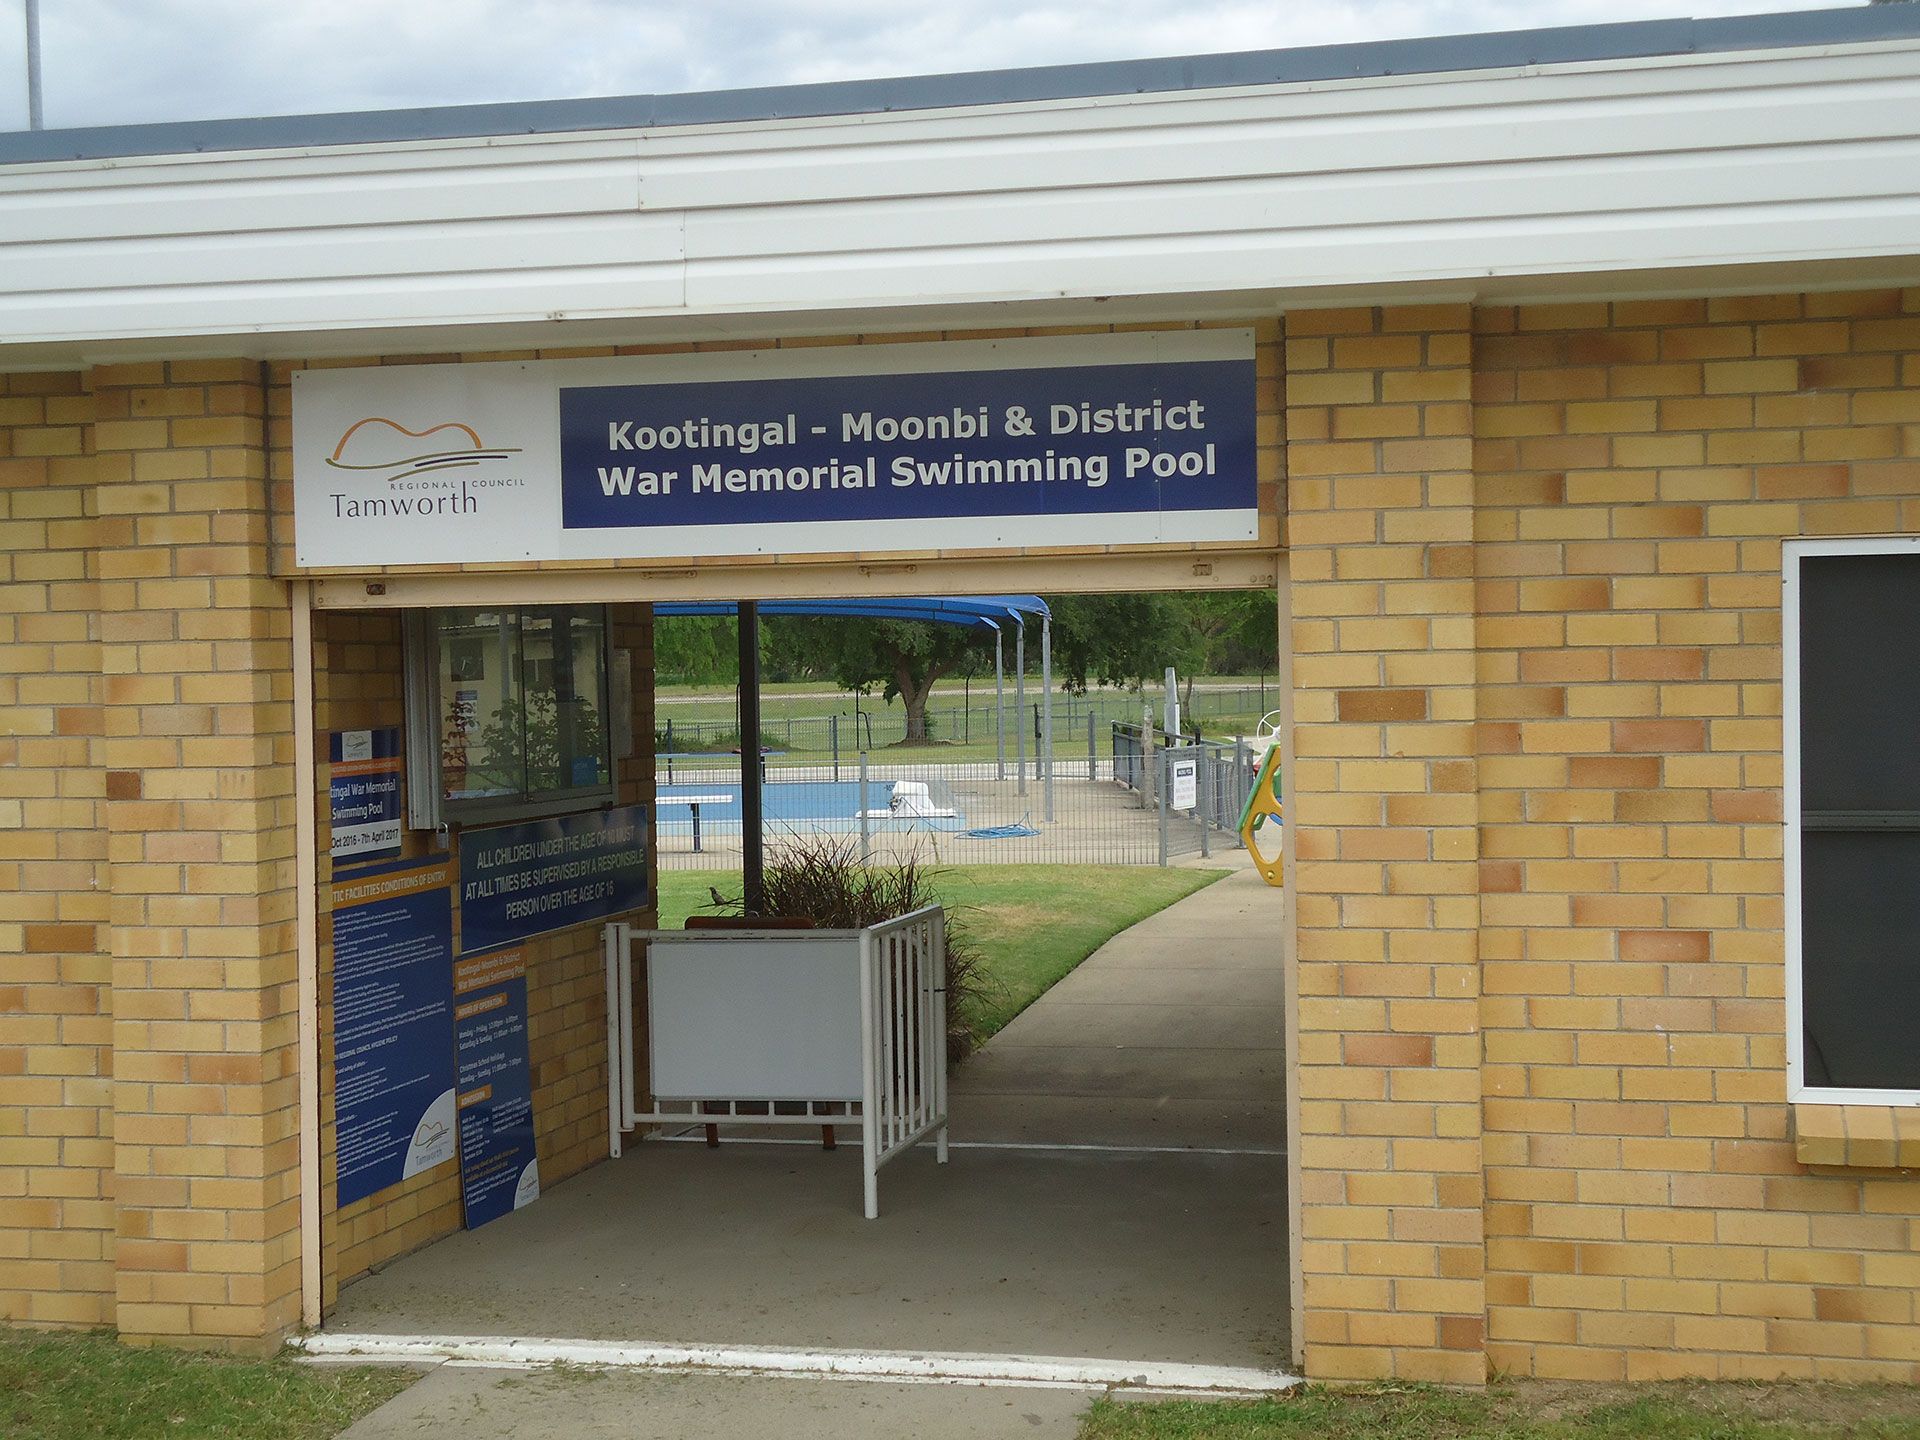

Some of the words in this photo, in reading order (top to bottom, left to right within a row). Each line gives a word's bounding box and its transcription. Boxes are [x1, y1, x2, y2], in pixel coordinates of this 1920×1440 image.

[608, 414, 796, 454] Kootingal
[811, 426, 827, 434] -
[842, 406, 988, 442] Moonbi
[1004, 405, 1037, 437] &
[1050, 399, 1205, 435] District
[390, 481, 457, 491] REGIONAL
[471, 478, 526, 488] COUNCIL
[597, 466, 678, 496] War
[691, 456, 876, 493] Memorial
[891, 449, 1109, 488] Swimming
[1125, 443, 1216, 478] Pool
[329, 480, 478, 518] Tamworth
[351, 783, 365, 796] War
[365, 778, 396, 794] Memorial
[332, 804, 368, 820] Swimming
[368, 800, 383, 815] Pool
[342, 835, 357, 847] 2016
[361, 833, 371, 844] 7th
[371, 830, 385, 844] April
[385, 828, 399, 841] 2017
[476, 851, 494, 870] ALL
[494, 843, 536, 865] CHILDREN
[536, 838, 564, 858] UNDER
[563, 835, 579, 853] THE
[580, 832, 596, 850] AGE
[596, 830, 607, 847] OF
[616, 825, 635, 842] MUST
[345, 883, 380, 900] FACILITIES
[380, 875, 419, 893] CONDITIONS
[419, 873, 427, 885] OF
[427, 870, 447, 884] ENTRY
[465, 882, 477, 900] AT
[477, 879, 495, 898] ALL
[494, 873, 520, 895] TIMES
[520, 871, 532, 890] BE
[532, 861, 579, 887] SUPERVISED
[579, 859, 591, 877] BY
[591, 858, 599, 874] A
[598, 848, 645, 873] RESPONSIBLE
[506, 898, 540, 920] PERSON
[540, 892, 562, 912] OVER
[562, 888, 578, 907] THE
[578, 884, 595, 903] AGE
[594, 882, 606, 899] OF
[606, 880, 615, 897] 16
[514, 962, 525, 975] Pool
